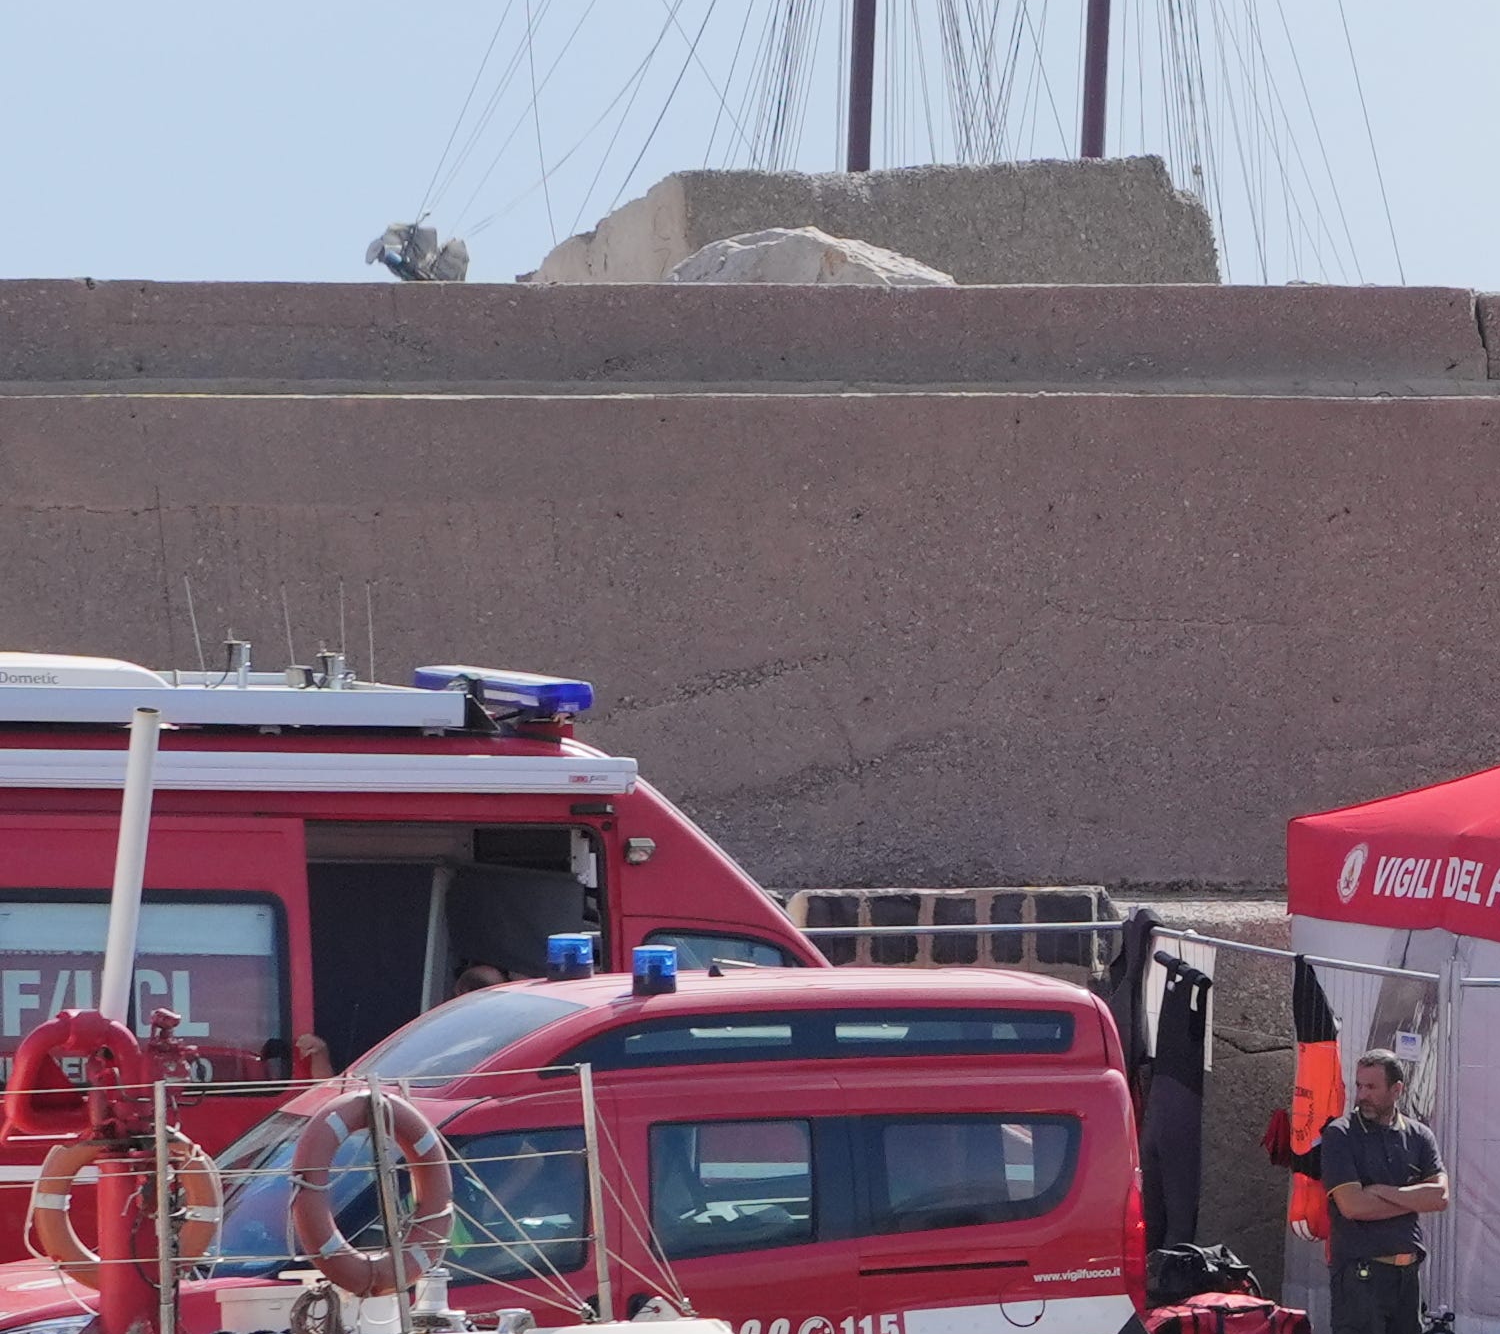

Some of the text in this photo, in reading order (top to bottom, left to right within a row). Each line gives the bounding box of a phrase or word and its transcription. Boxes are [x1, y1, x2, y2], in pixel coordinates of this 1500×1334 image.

[0, 671, 60, 685] Dometic
[1373, 855, 1443, 899] VIGILI
[1442, 856, 1484, 905] DEL
[1033, 1266, 1122, 1283] www.vigilfuoco.it
